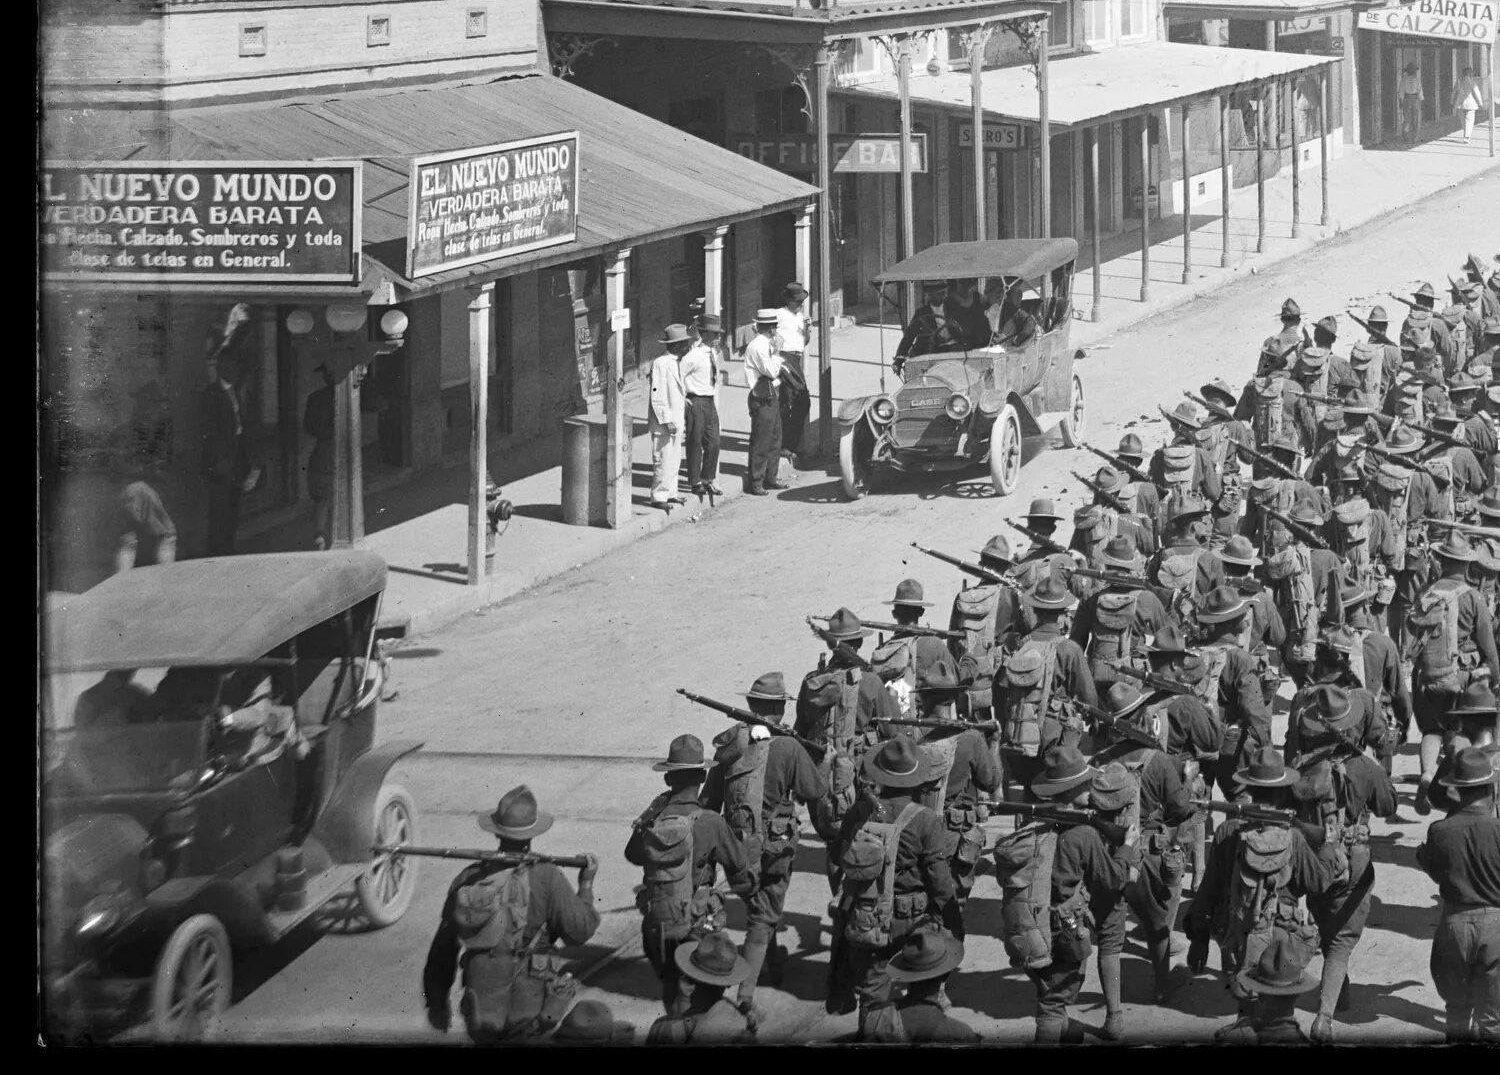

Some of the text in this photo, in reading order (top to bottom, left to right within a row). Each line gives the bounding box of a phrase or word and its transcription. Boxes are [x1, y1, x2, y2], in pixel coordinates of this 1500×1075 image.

[1420, 0, 1493, 21] BARATA
[1366, 12, 1488, 40] DE CALZADO
[962, 128, 1014, 143] SRO'S
[421, 145, 569, 197] EL NUEVO MUNDO
[80, 173, 200, 201] NUEVO
[213, 173, 336, 202] MUNDO
[429, 175, 562, 218] VERDADERA BARATA
[209, 206, 324, 224] BARATA
[418, 221, 441, 242] Ropa
[544, 202, 550, 217] y
[552, 195, 569, 212] toda
[190, 227, 279, 246] Sombreros
[286, 234, 297, 249] y
[304, 229, 342, 246] toda
[469, 232, 480, 251] de
[502, 232, 511, 242] en
[116, 249, 136, 266] de
[142, 249, 187, 267] telas
[193, 255, 214, 267] en
[220, 249, 291, 268] General.
[911, 398, 941, 407] CASE
